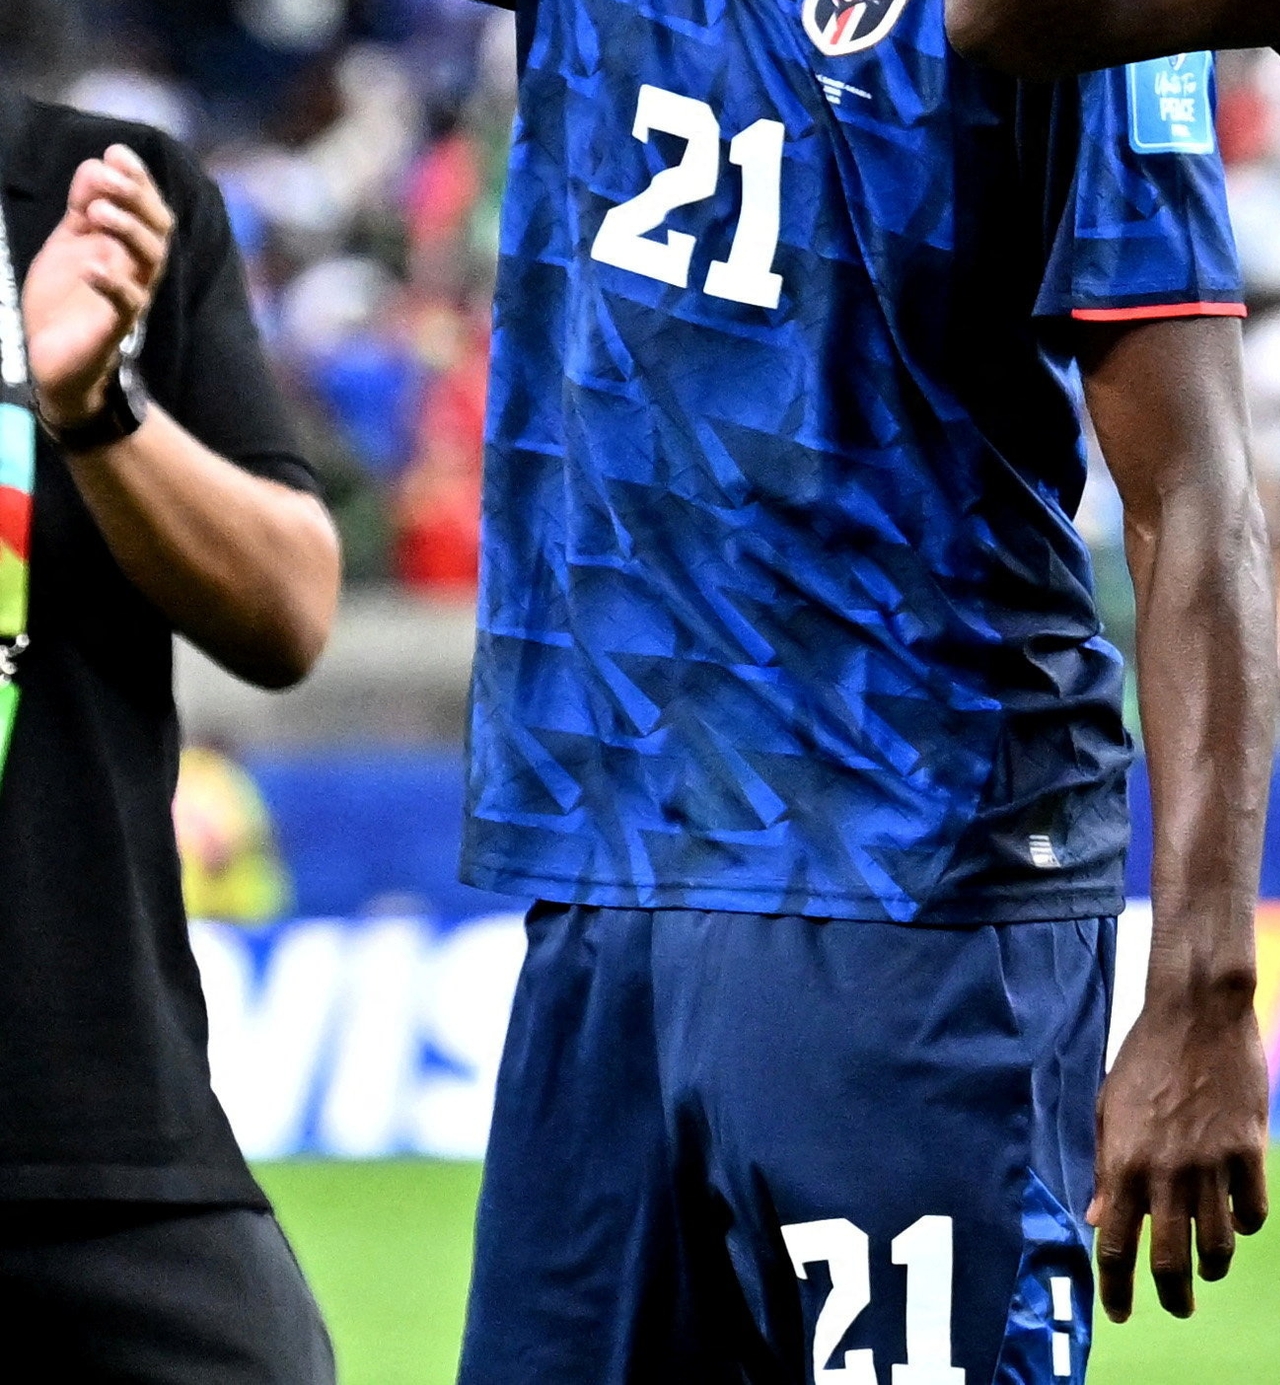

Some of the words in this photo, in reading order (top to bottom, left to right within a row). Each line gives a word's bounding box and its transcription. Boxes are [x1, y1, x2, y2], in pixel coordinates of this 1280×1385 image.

[590, 84, 784, 309] 21
[185, 914, 528, 1161] VIS
[781, 1215, 965, 1385] 21
